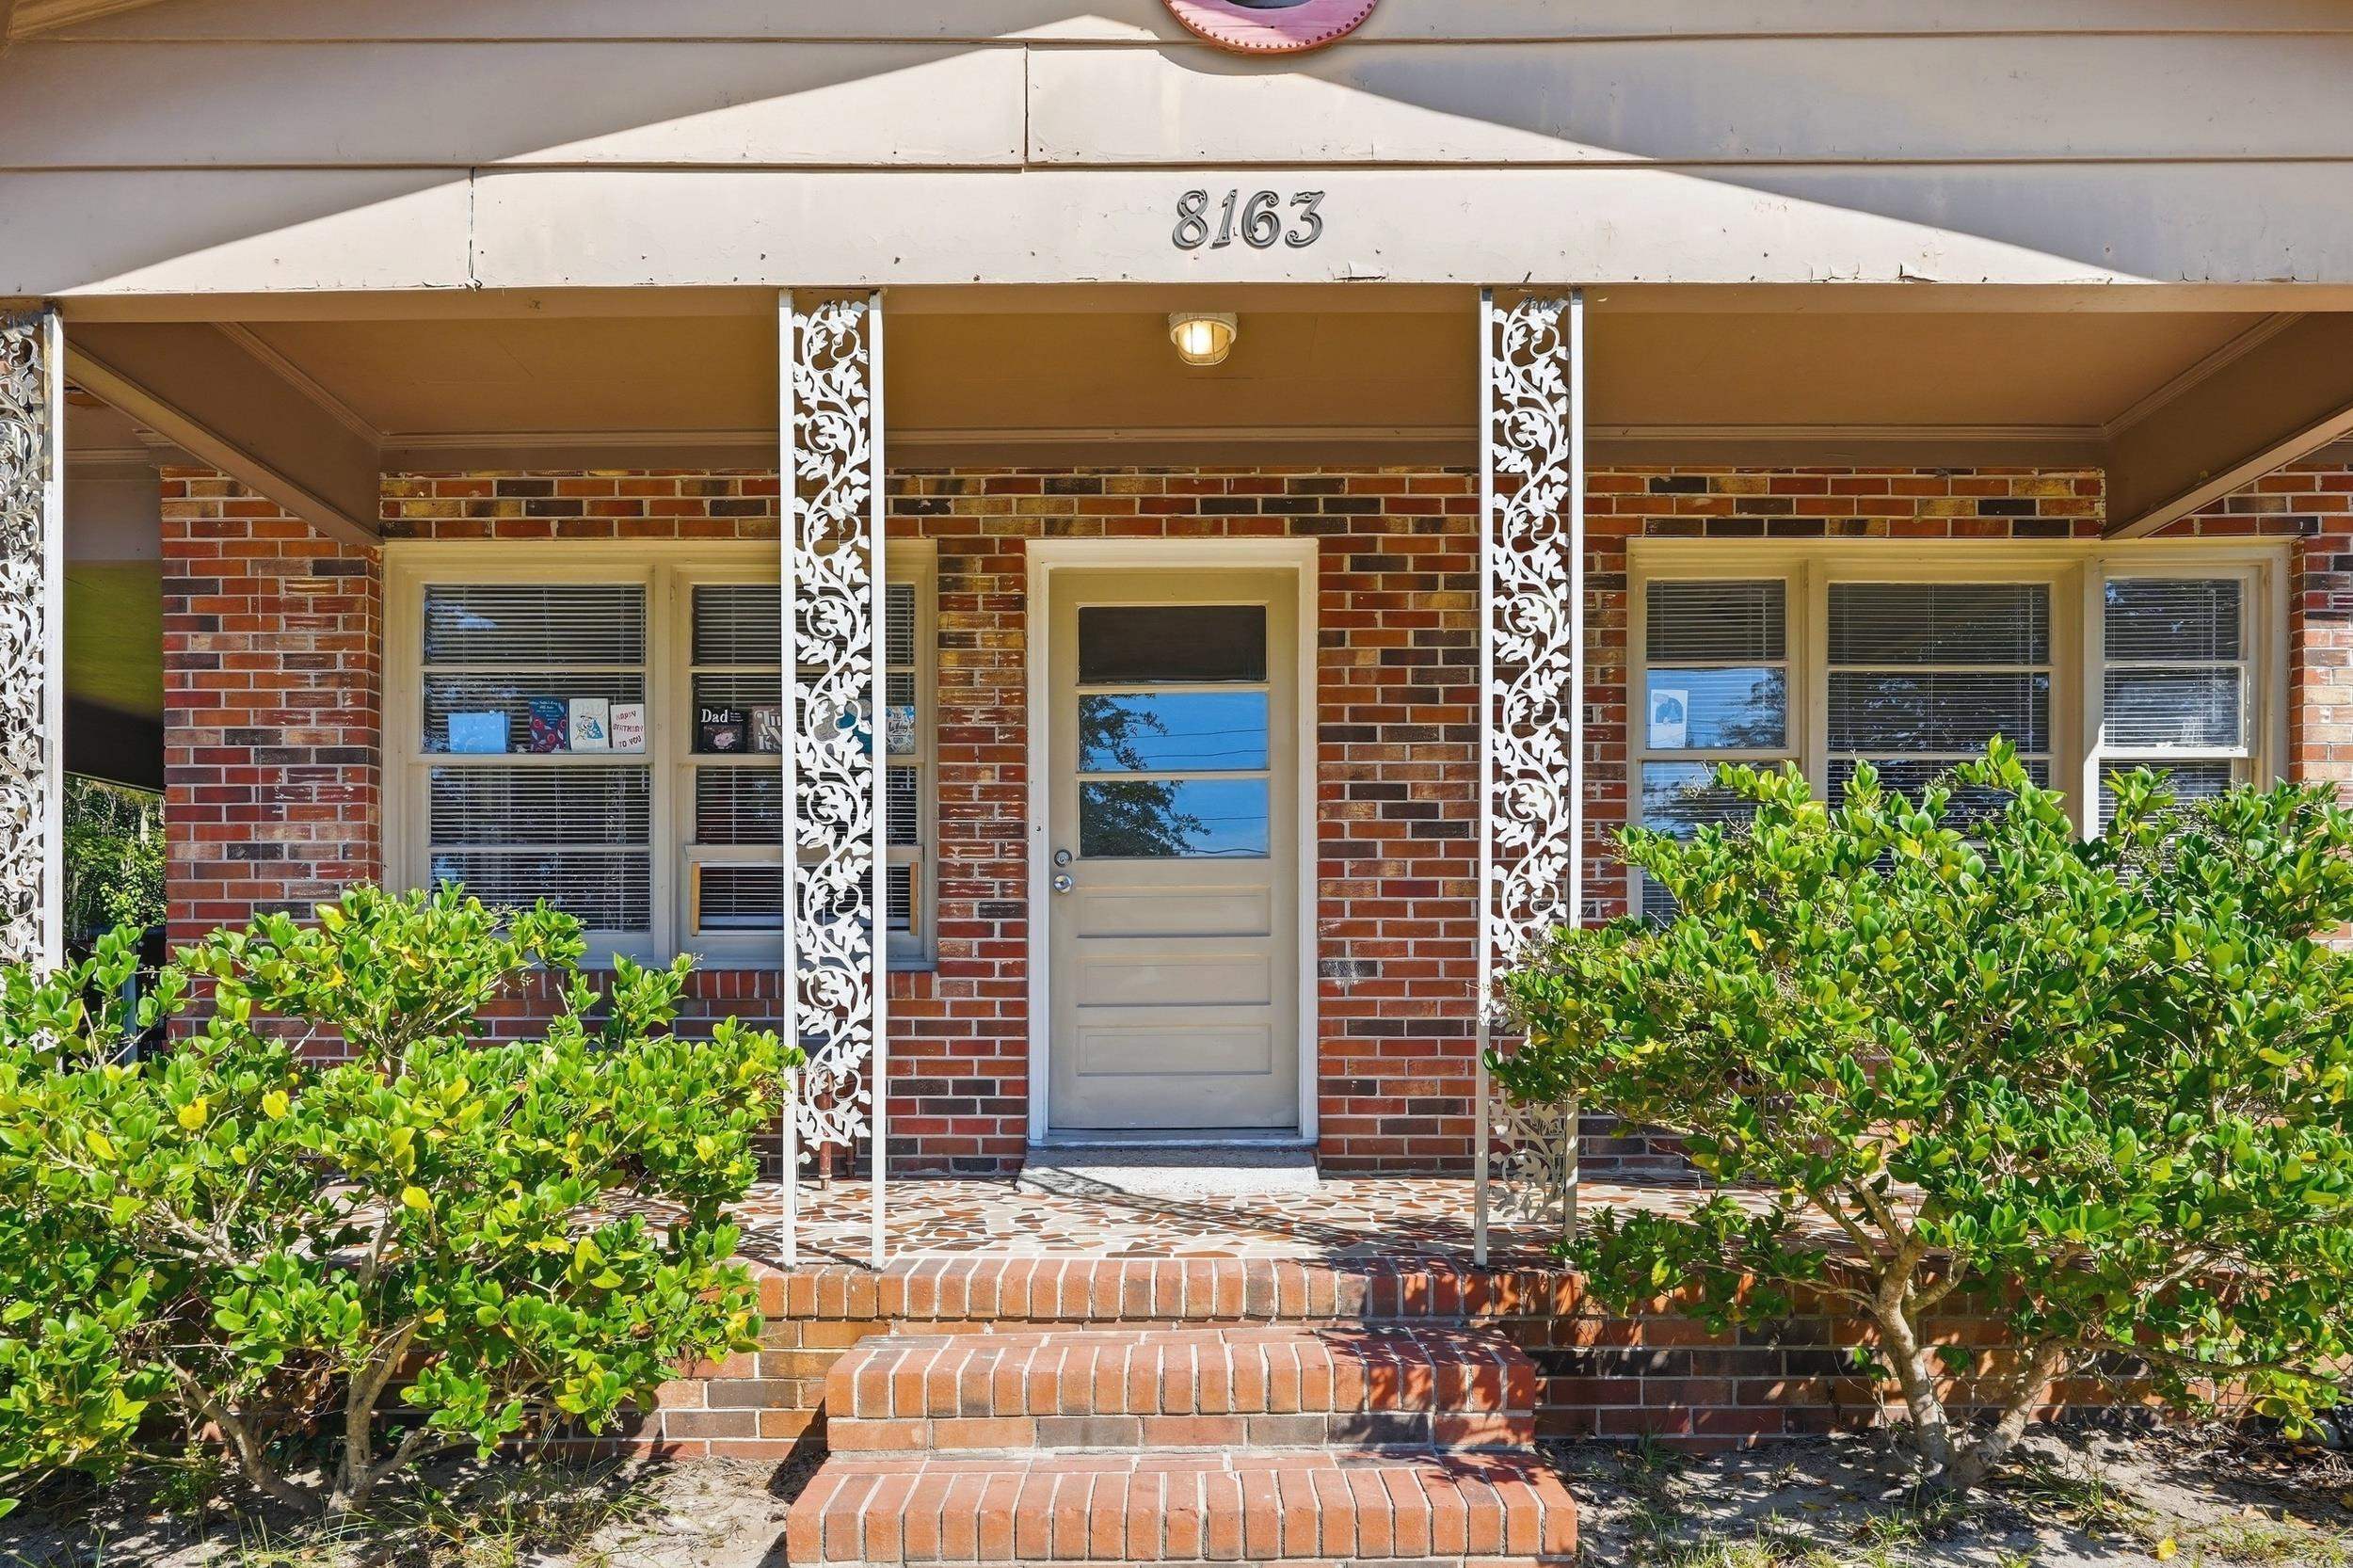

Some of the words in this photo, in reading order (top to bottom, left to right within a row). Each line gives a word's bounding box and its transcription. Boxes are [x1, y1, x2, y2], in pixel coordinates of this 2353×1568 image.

[1173, 188, 1325, 250] 8163
[700, 709, 728, 723] Dad
[618, 740, 627, 748] TO
[629, 735, 642, 745] YOU
